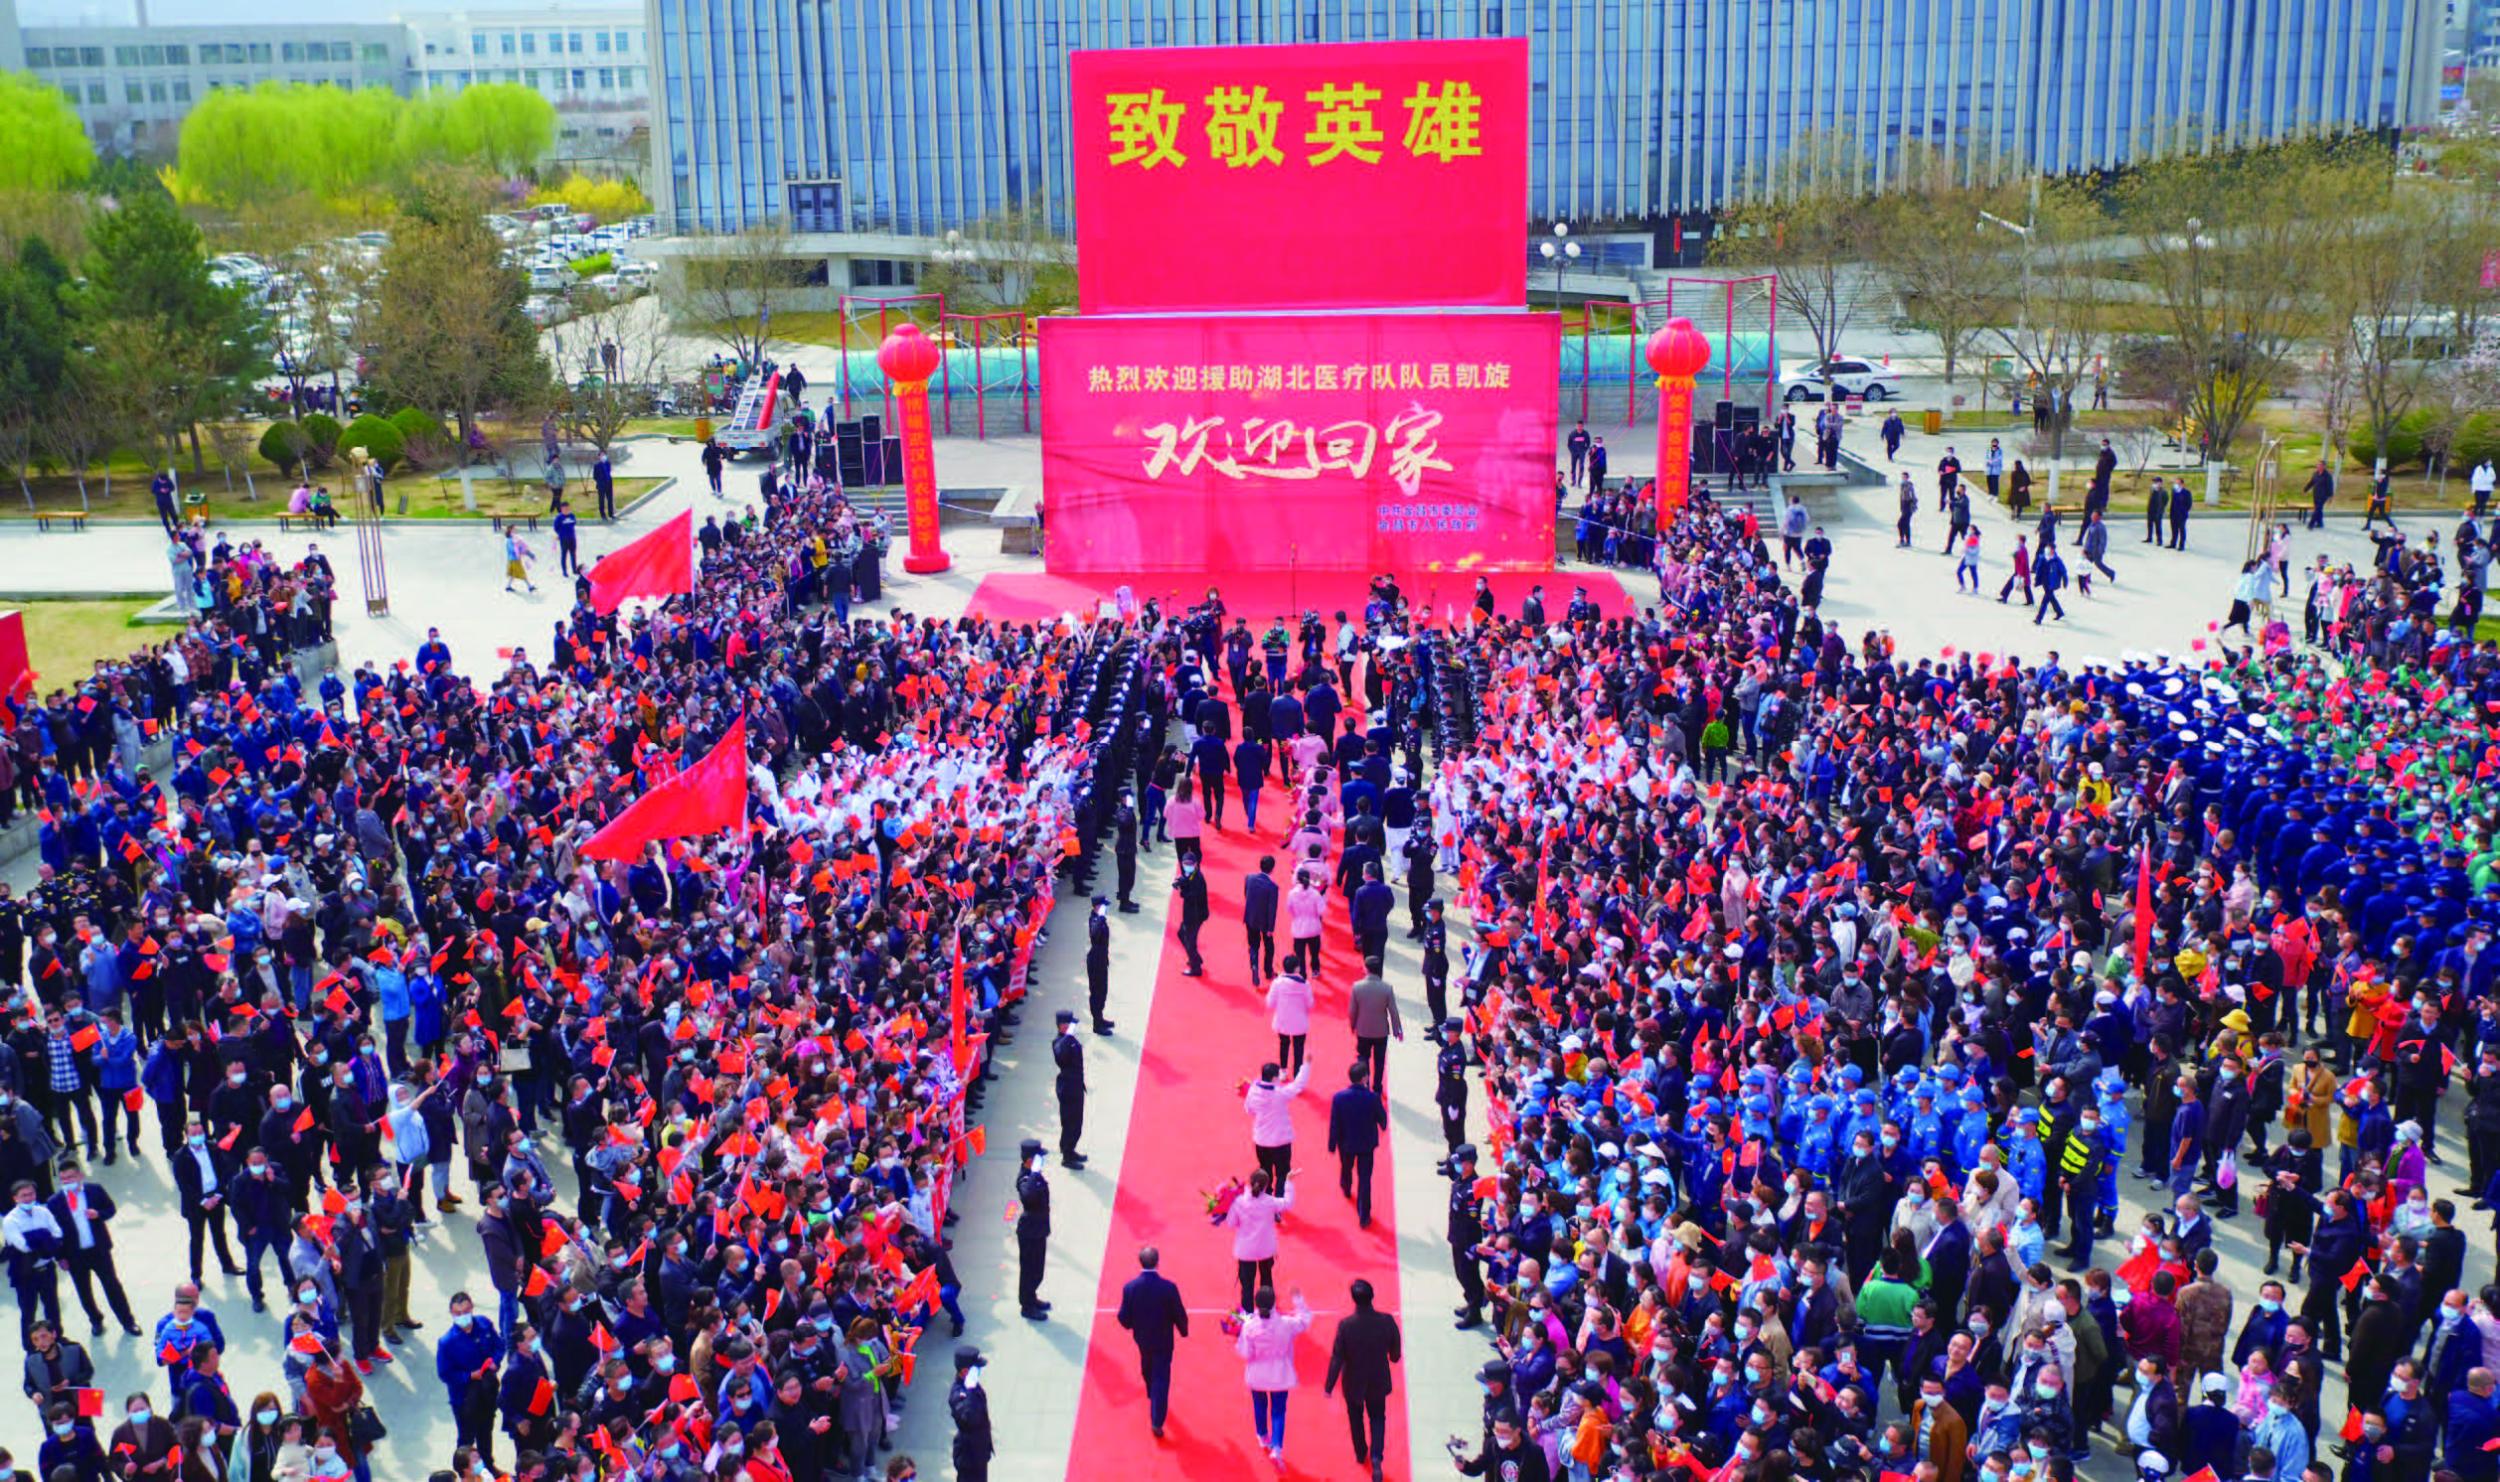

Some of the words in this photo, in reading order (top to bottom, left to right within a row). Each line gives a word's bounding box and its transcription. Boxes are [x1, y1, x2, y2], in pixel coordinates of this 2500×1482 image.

[1106, 80, 1482, 168] 致敬英雄
[1088, 363, 1511, 392] 热烈欢迎援助湖北医疗队队员凯旋
[1142, 402, 1454, 496] 欢迎回家
